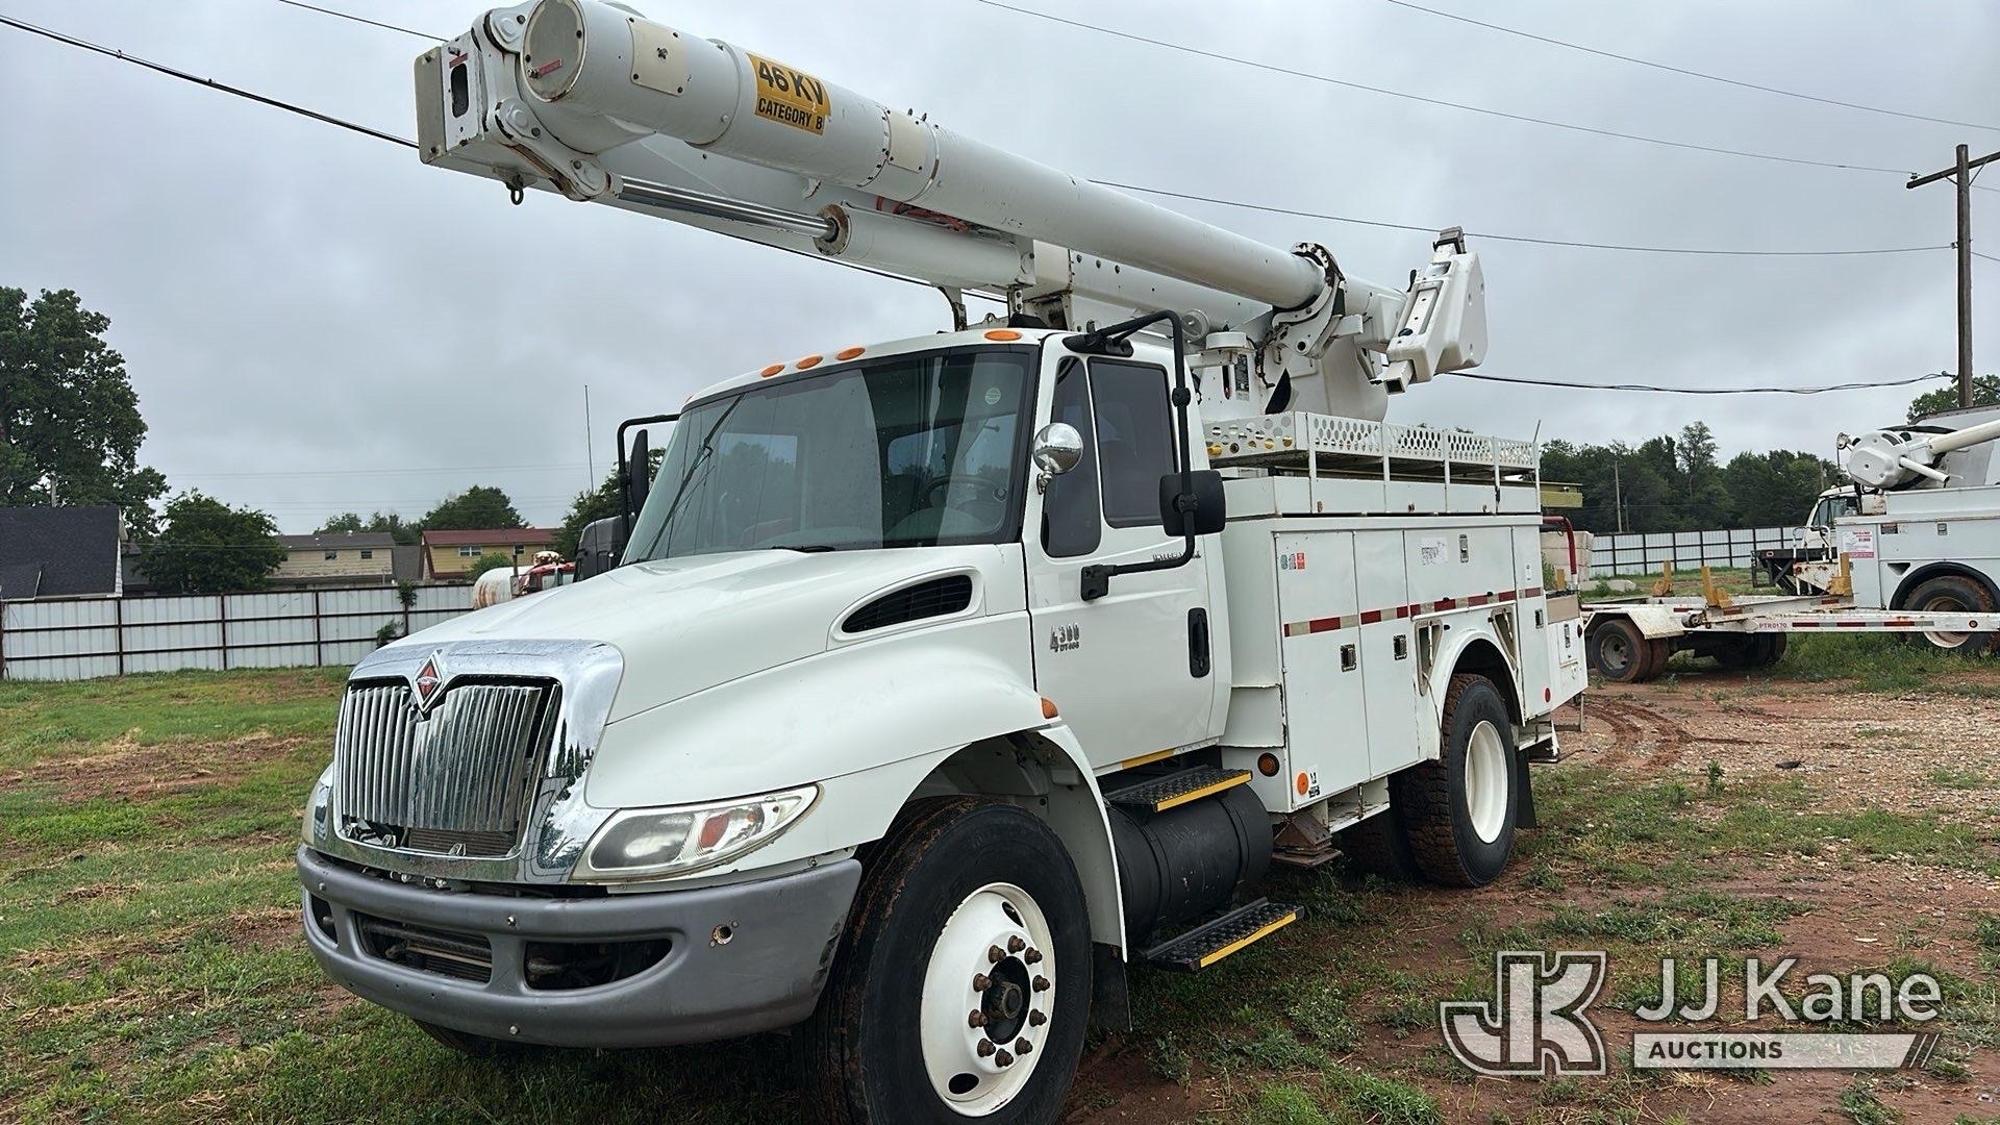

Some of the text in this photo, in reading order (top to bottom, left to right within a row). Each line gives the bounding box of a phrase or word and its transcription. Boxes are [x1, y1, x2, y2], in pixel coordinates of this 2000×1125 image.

[759, 61, 823, 105] 46 KV
[758, 97, 823, 130] CATEGORY B
